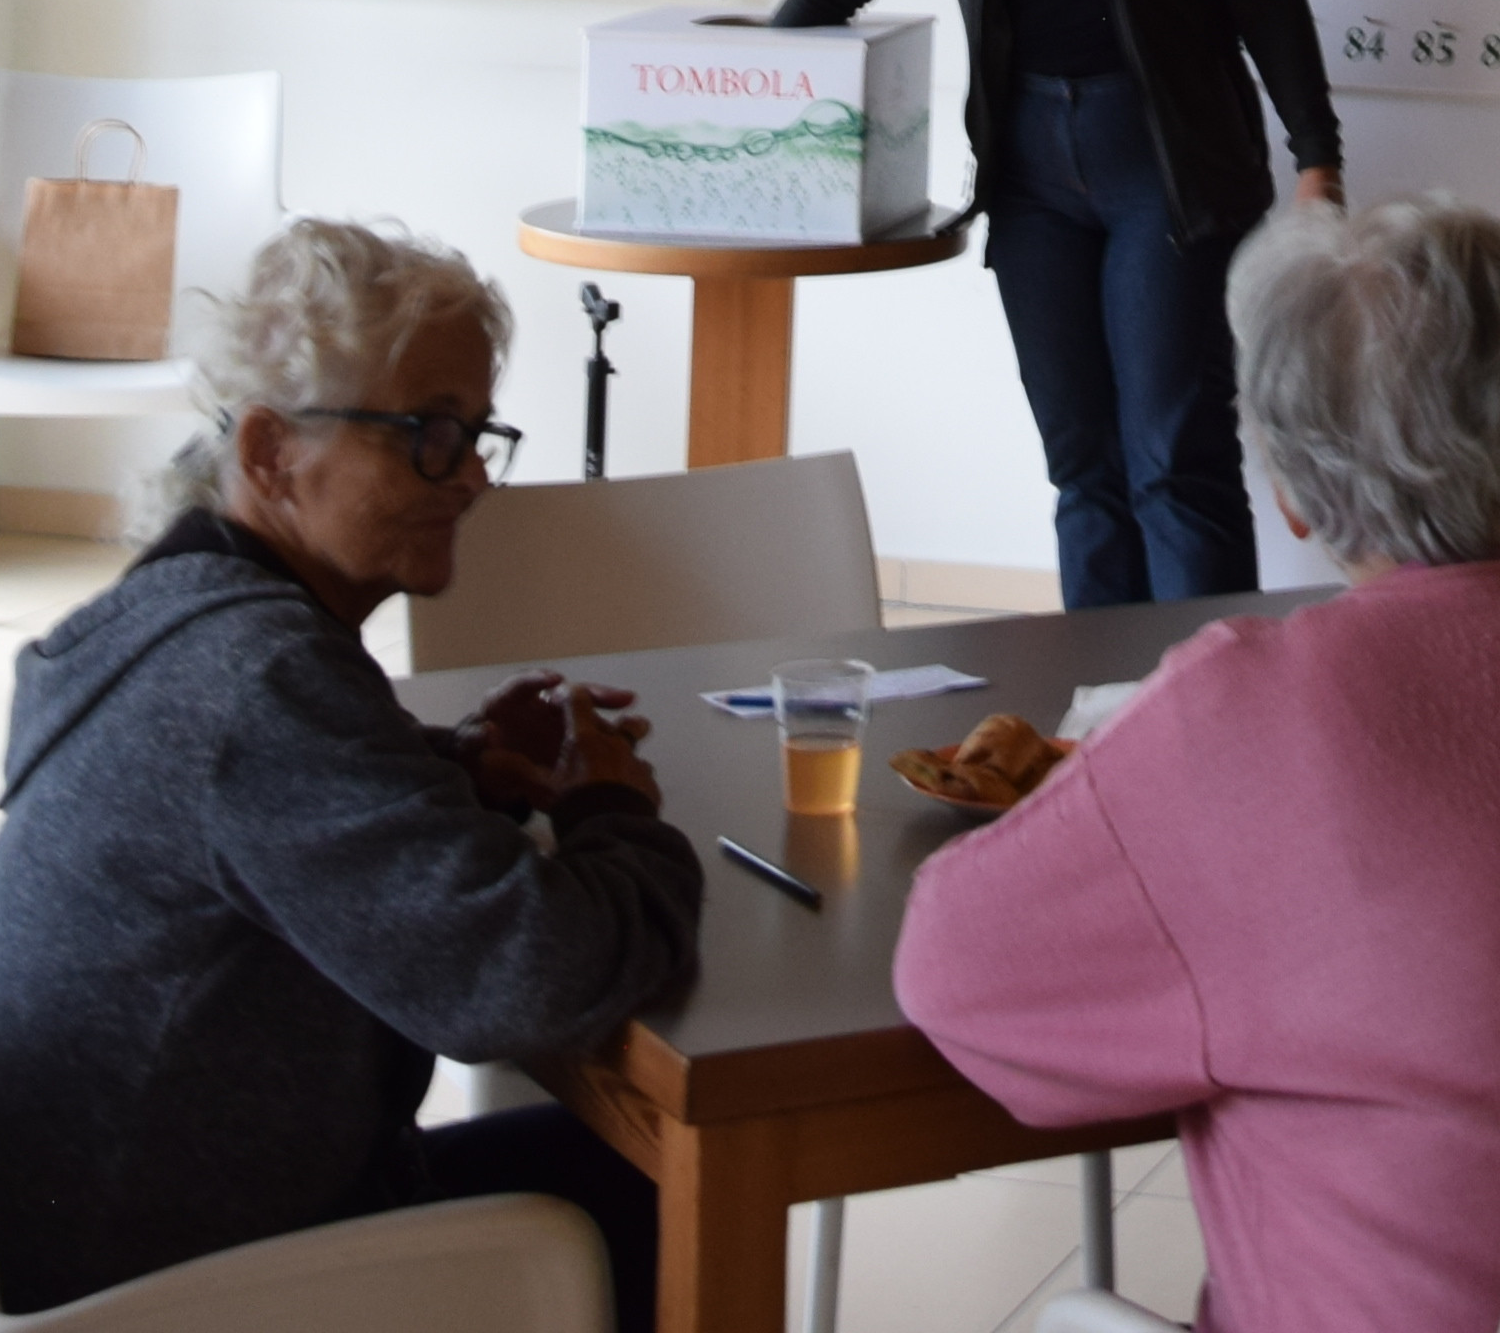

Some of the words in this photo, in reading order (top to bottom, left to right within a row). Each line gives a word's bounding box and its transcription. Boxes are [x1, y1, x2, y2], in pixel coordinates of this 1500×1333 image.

[1342, 25, 1388, 63] 84
[1411, 30, 1457, 67] 85
[631, 64, 815, 99] TOMBOLA
